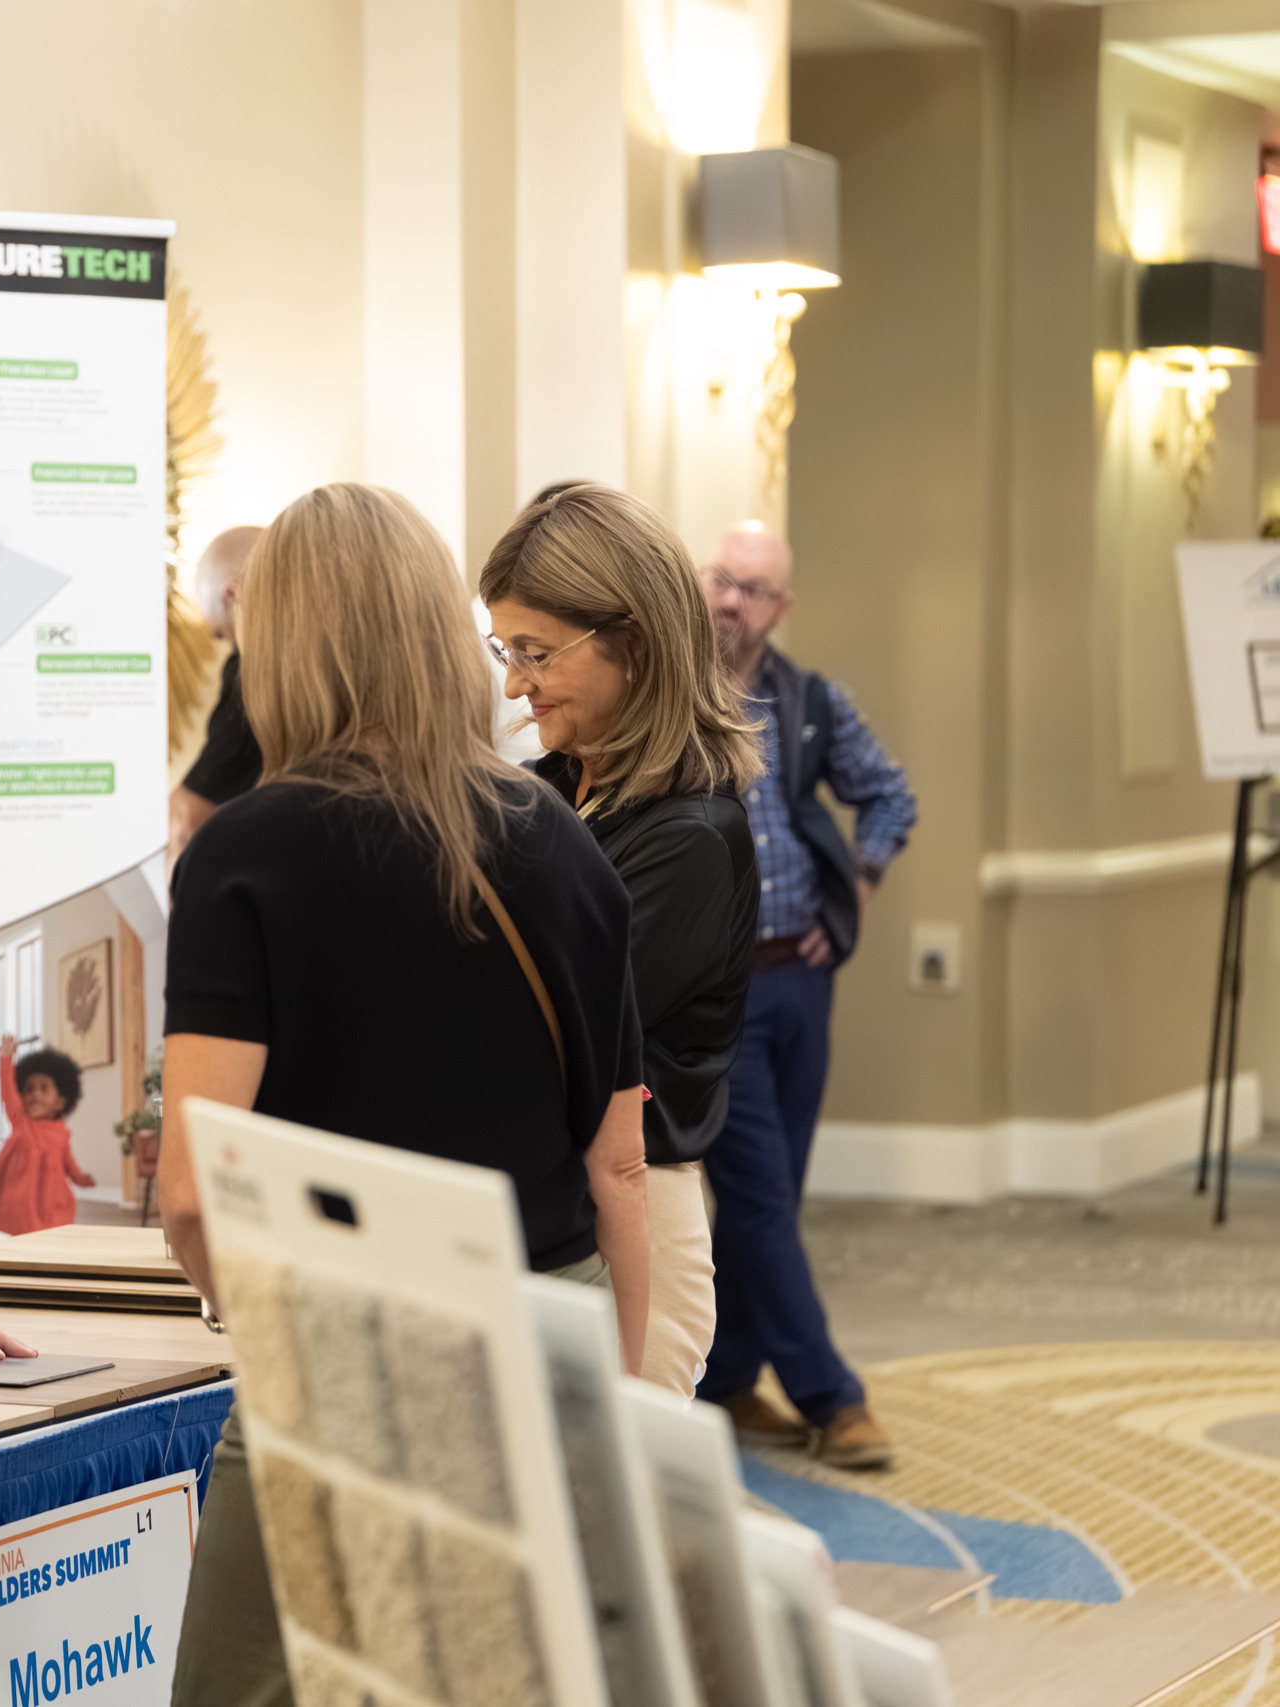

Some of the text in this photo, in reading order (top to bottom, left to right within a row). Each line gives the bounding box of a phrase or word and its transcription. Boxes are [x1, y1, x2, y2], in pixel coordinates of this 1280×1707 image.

[136, 1508, 153, 1535] L1
[55, 1537, 131, 1587] SUMMIT
[9, 1614, 156, 1707] Mohawk
